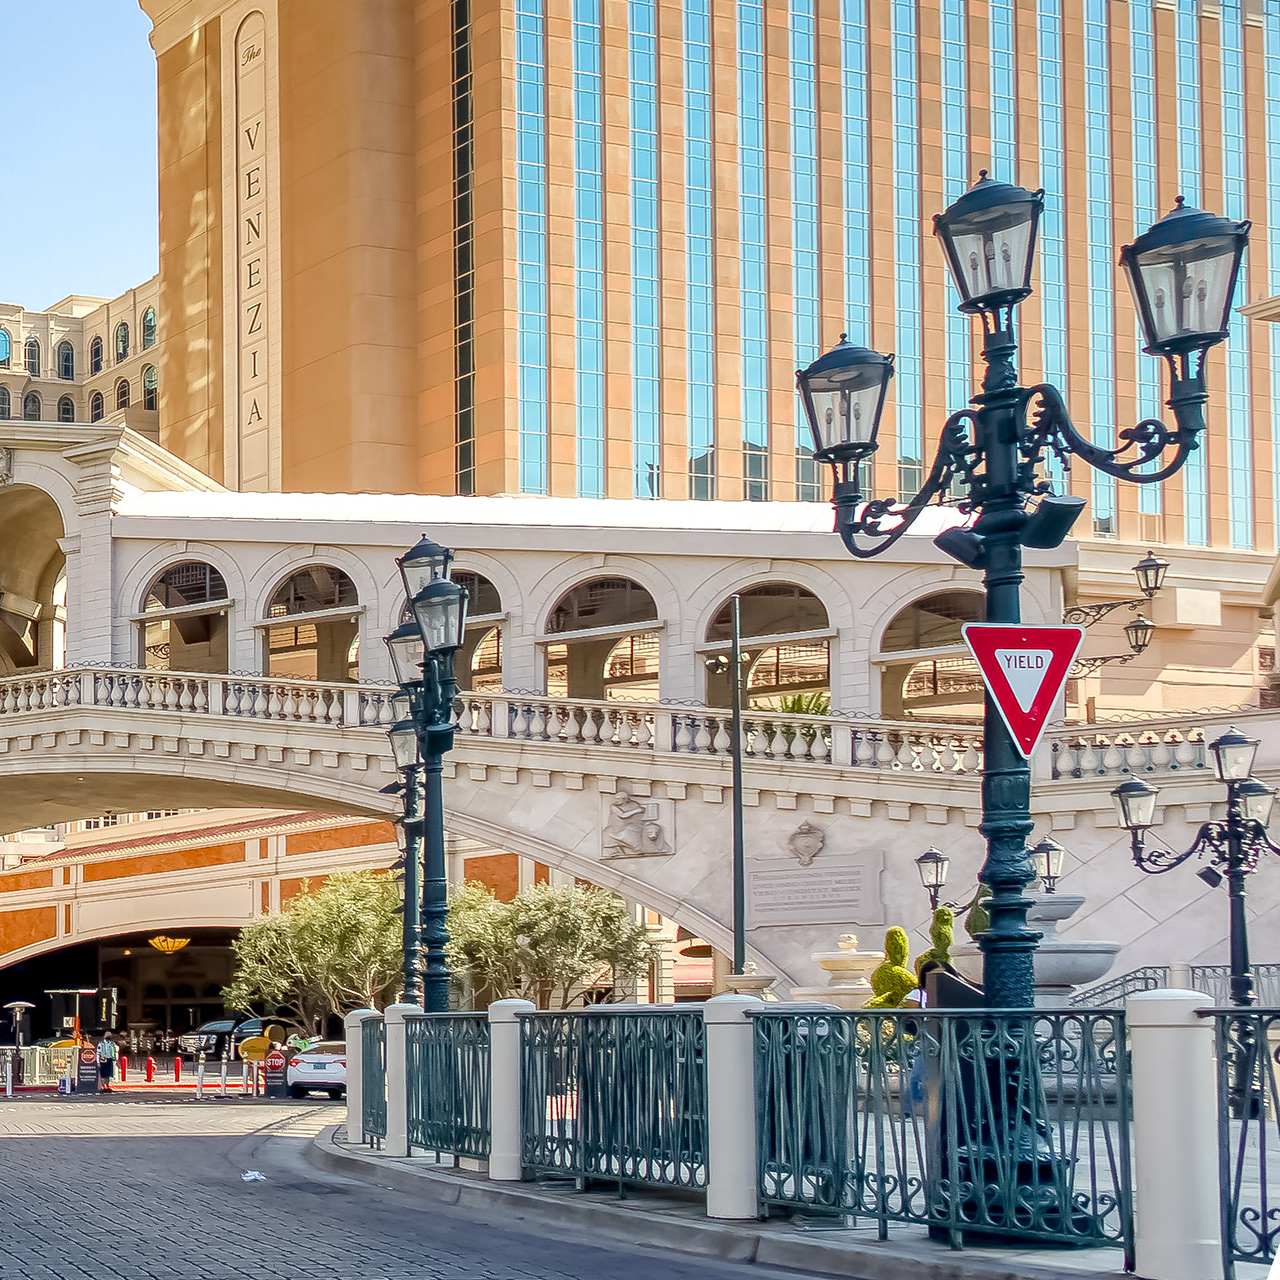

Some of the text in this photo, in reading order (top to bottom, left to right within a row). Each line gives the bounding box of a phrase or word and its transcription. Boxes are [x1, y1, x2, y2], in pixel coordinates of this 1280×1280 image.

[241, 43, 263, 426] The VENEZIA
[1003, 654, 1045, 670] YIELD
[266, 1057, 284, 1066] STOP
